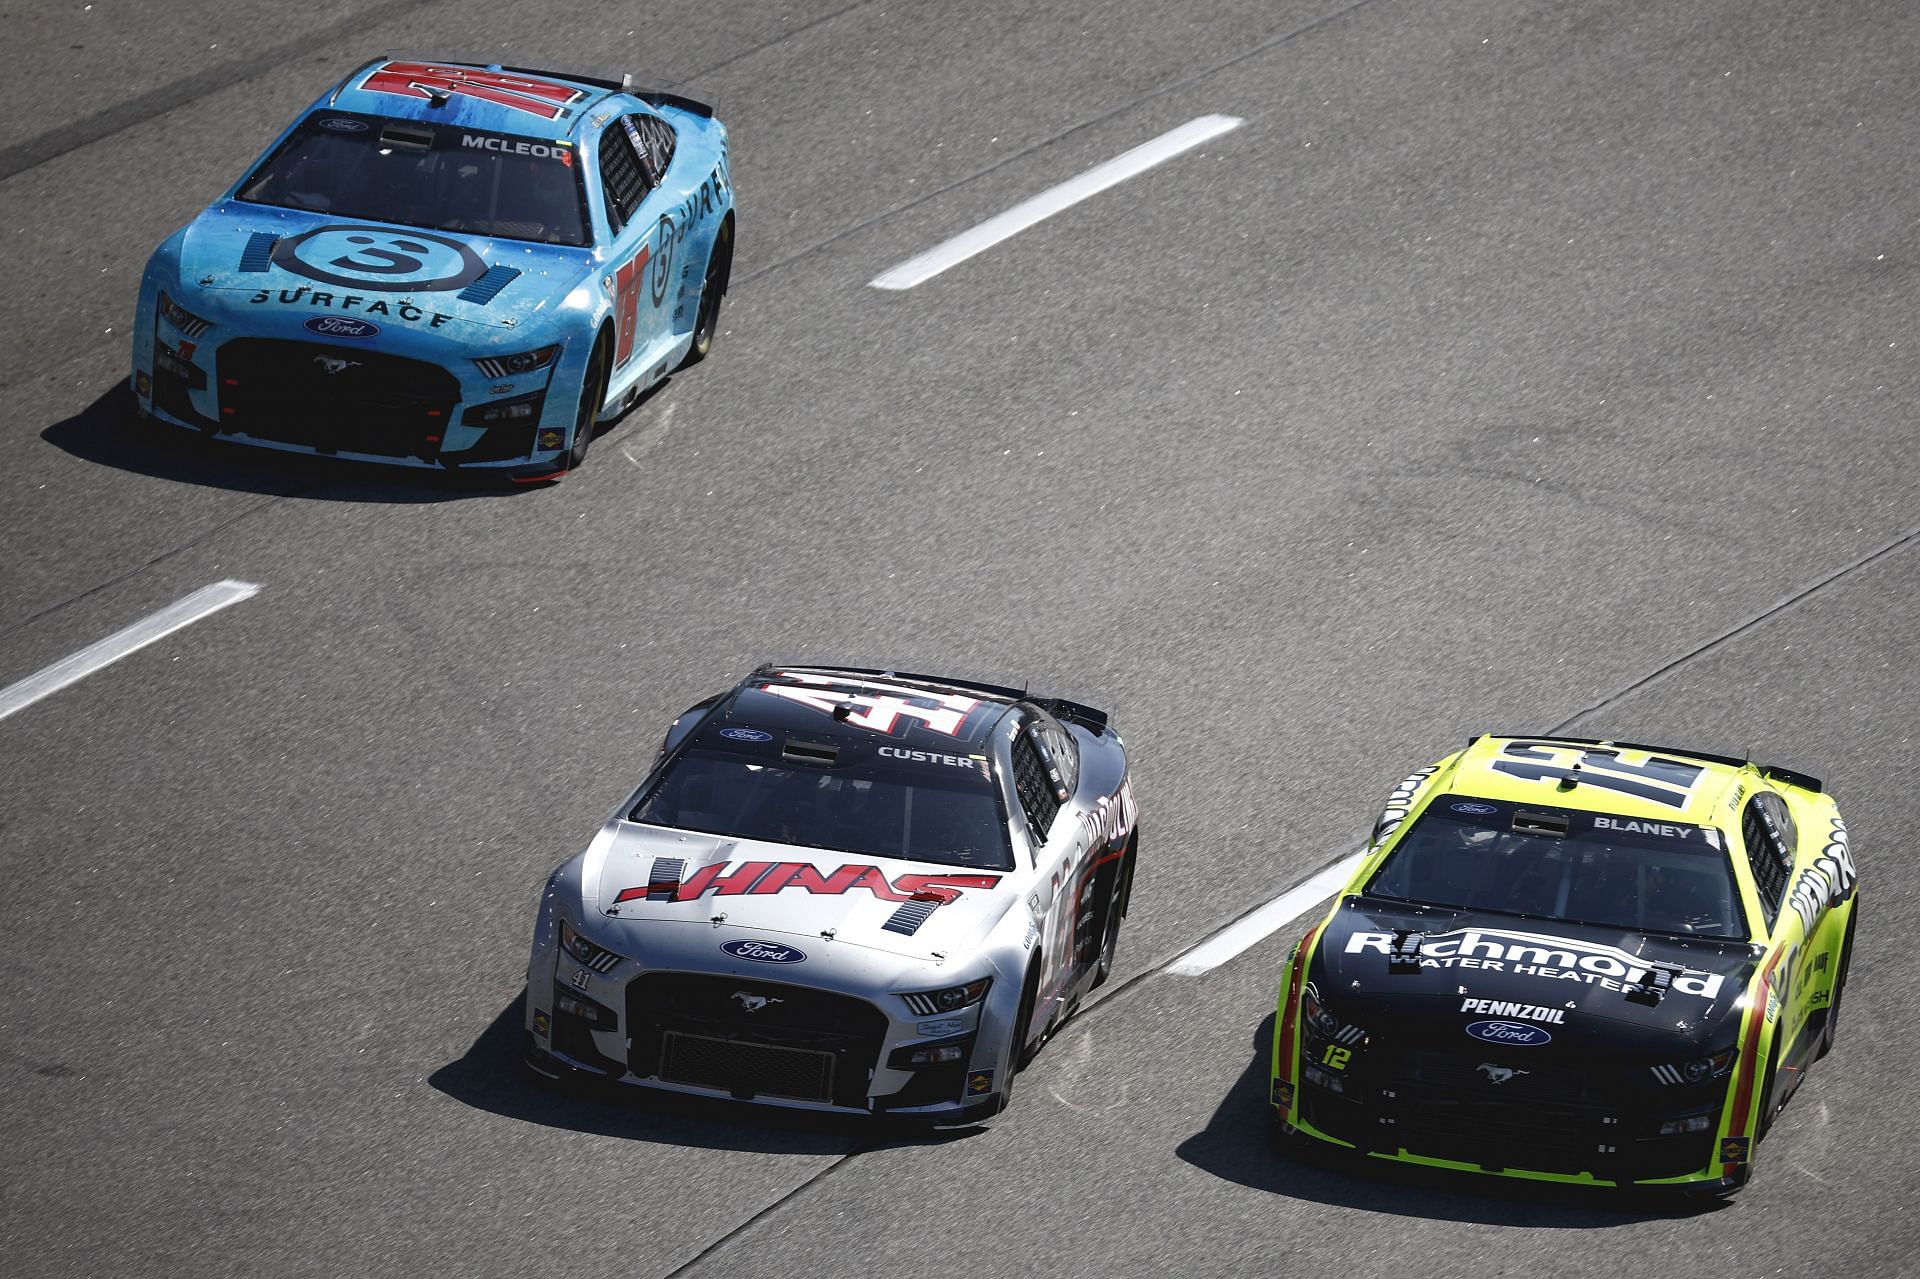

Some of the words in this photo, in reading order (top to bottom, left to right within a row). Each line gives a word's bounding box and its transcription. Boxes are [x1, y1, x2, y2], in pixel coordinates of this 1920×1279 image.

[462, 135, 570, 160] MCLEOD
[250, 289, 454, 328] SURFACE
[878, 746, 975, 768] CUSTER
[1593, 817, 1692, 839] BLANEY
[613, 861, 1003, 906] HAAS
[1344, 931, 1726, 999] Richmond
[571, 970, 591, 991] 41
[1460, 998, 1566, 1025] PENNZOIL
[1322, 1044, 1352, 1070] 12
